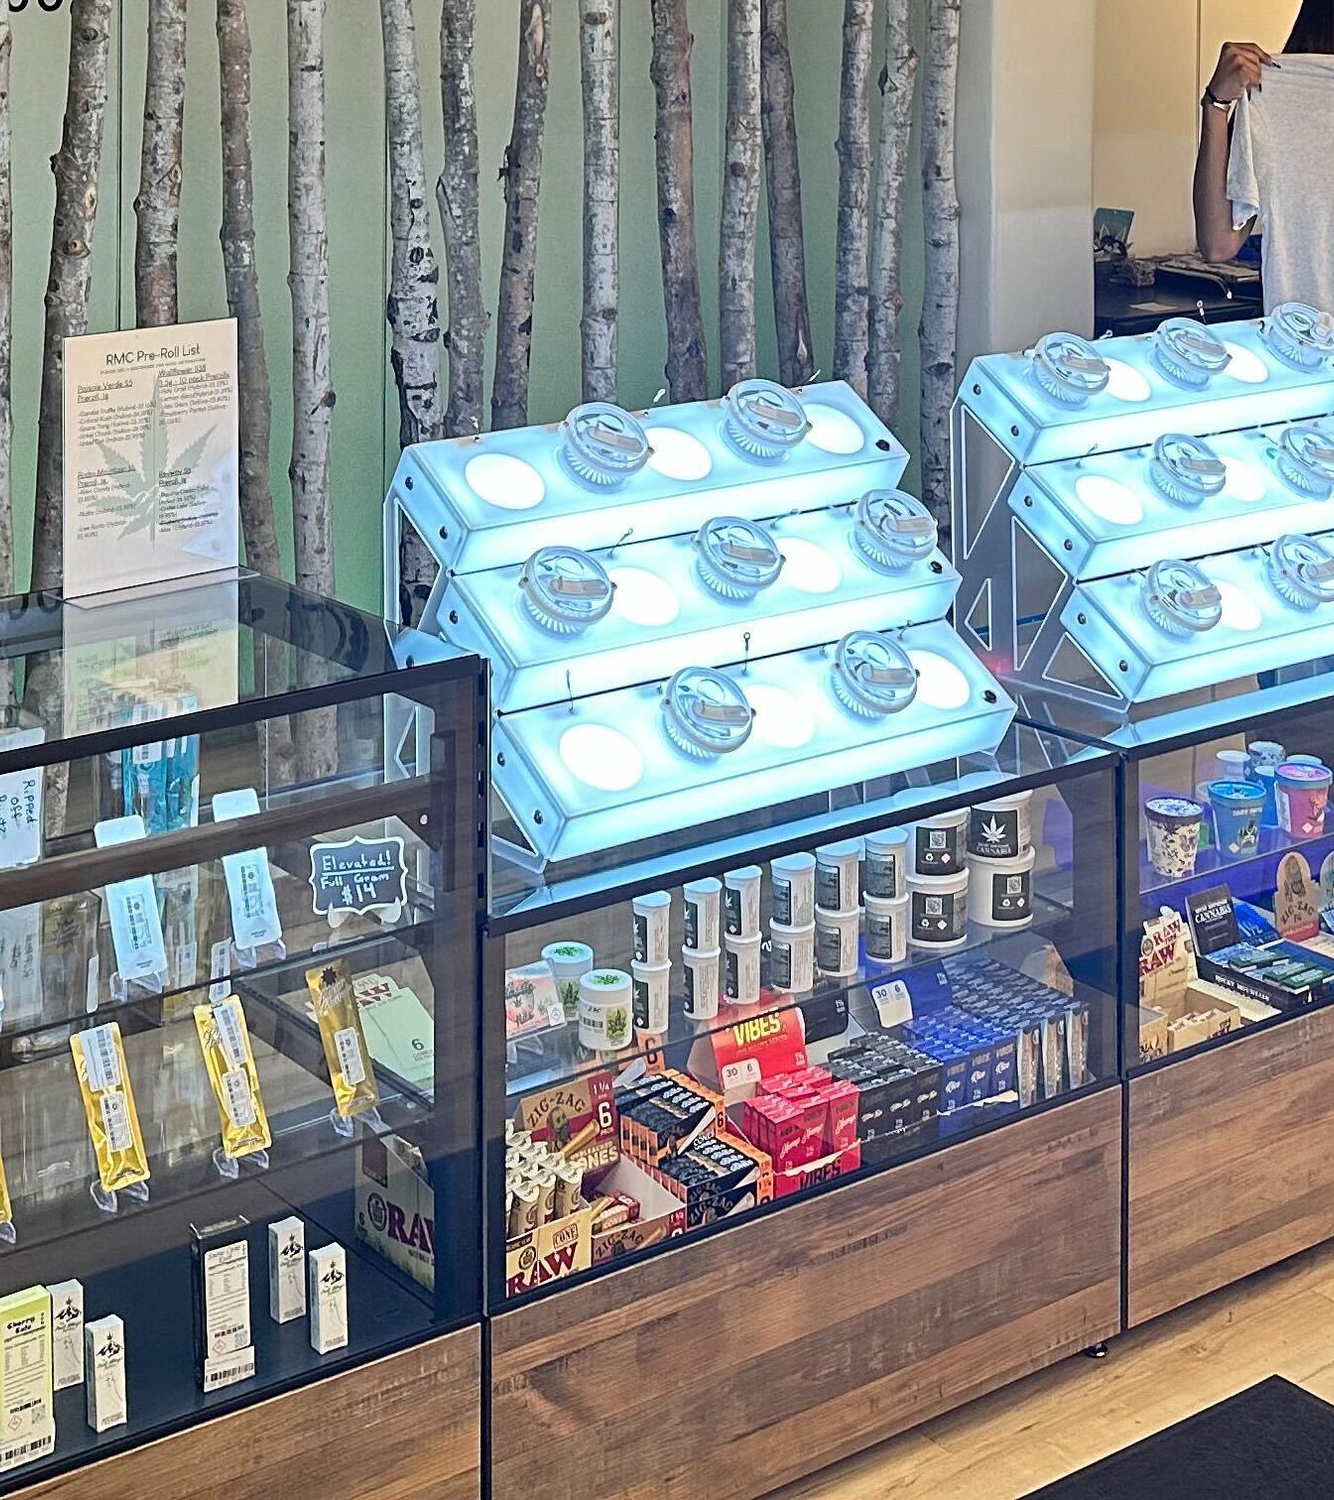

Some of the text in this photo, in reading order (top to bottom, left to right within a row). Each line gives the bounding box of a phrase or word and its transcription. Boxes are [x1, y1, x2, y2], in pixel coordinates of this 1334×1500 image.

[106, 343, 201, 366] RMC Pre-Roll List
[23, 779, 38, 824] Ripped
[322, 849, 391, 871] Elevated!
[320, 873, 390, 890] Full Gram
[341, 882, 377, 906] $14
[1194, 904, 1232, 924] CANNABIS
[1153, 919, 1181, 946] RAW
[1139, 942, 1175, 977] RAW
[876, 989, 887, 999] 30
[894, 984, 900, 994] 6
[734, 1012, 782, 1047] VIBES
[411, 1038, 424, 1051] 6
[727, 1067, 738, 1077] 30
[747, 1063, 752, 1072] 6
[527, 1091, 587, 1128] ZIG-ZAG
[598, 1102, 613, 1128] 6
[359, 1211, 365, 1226] 6
[507, 1241, 579, 1297] RAW
